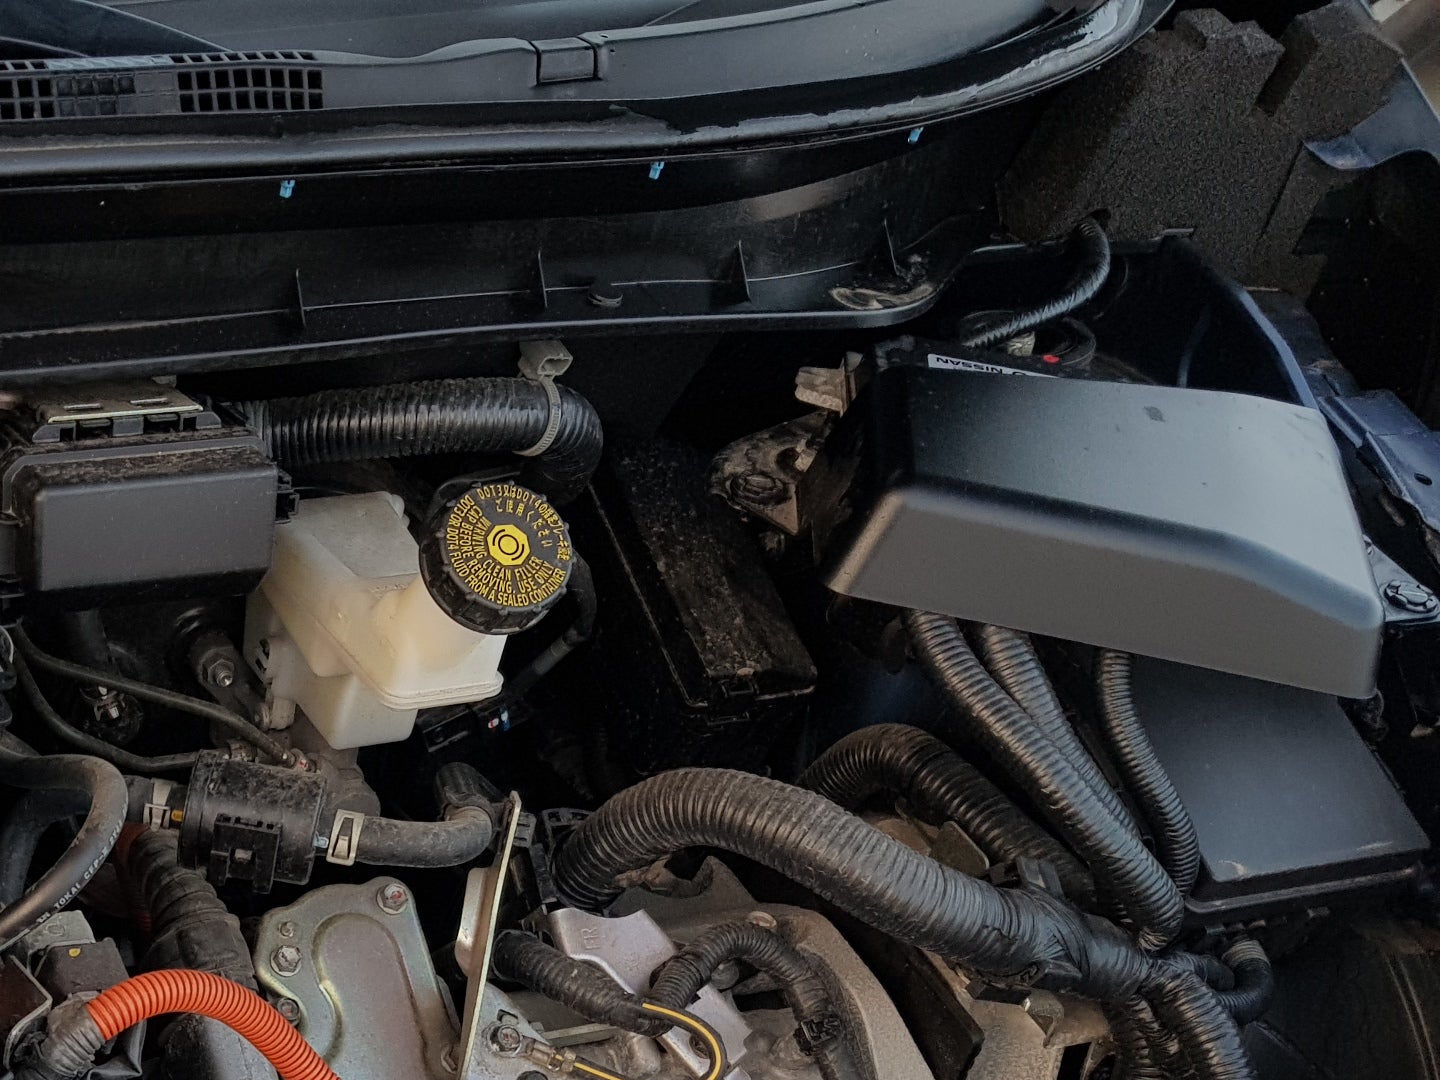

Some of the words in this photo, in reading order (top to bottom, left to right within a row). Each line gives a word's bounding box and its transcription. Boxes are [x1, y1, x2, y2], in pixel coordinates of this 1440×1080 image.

[936, 357, 1003, 374] NISSAN
[453, 495, 475, 516] DOT3
[466, 506, 483, 523] CAP
[448, 514, 461, 526] OR
[446, 527, 460, 550] DOT4
[460, 522, 474, 558] BEFORE
[472, 516, 492, 559] WARNING
[483, 559, 512, 580] CLEAN
[514, 556, 543, 580] FILLER
[449, 551, 468, 577] FLUID
[535, 561, 555, 584] ONLY
[465, 575, 489, 598] FROM
[488, 590, 495, 602] A
[518, 579, 537, 594] USE
[529, 567, 567, 604] CONTAINER
[497, 593, 529, 607] SEALED
